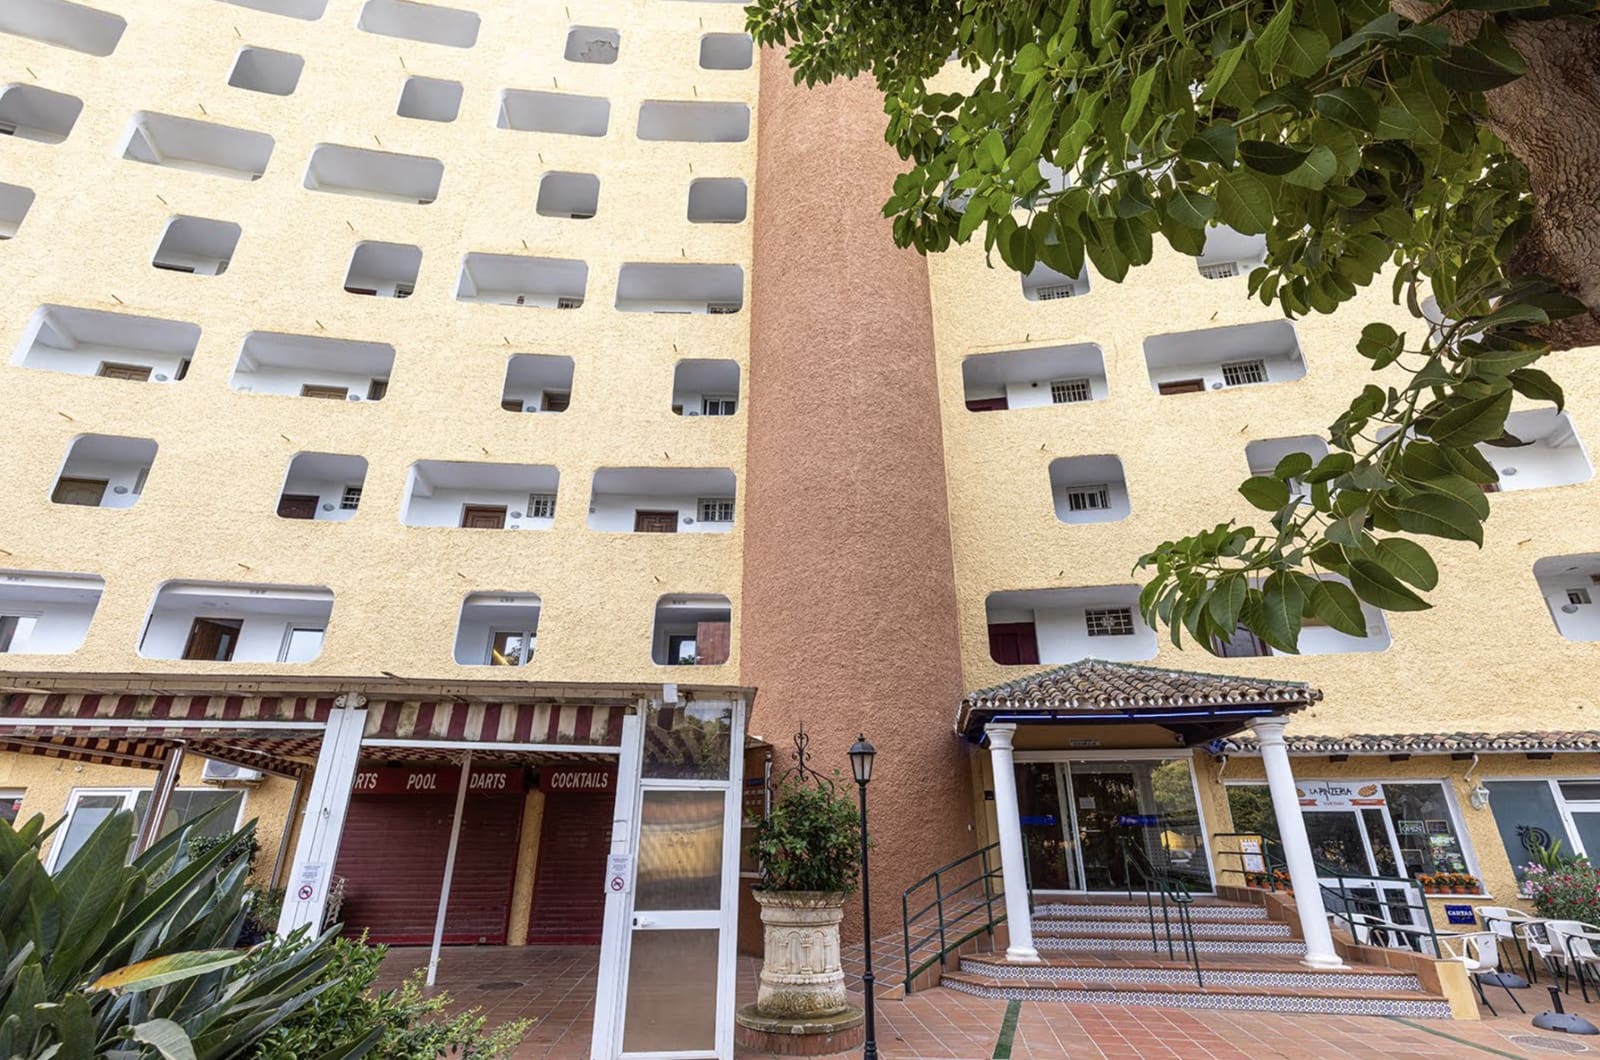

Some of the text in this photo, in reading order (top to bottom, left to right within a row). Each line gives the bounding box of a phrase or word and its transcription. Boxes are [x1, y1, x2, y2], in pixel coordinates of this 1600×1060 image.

[353, 772, 507, 789] RTS POOL DARTS
[551, 772, 609, 789] COCKTAILS
